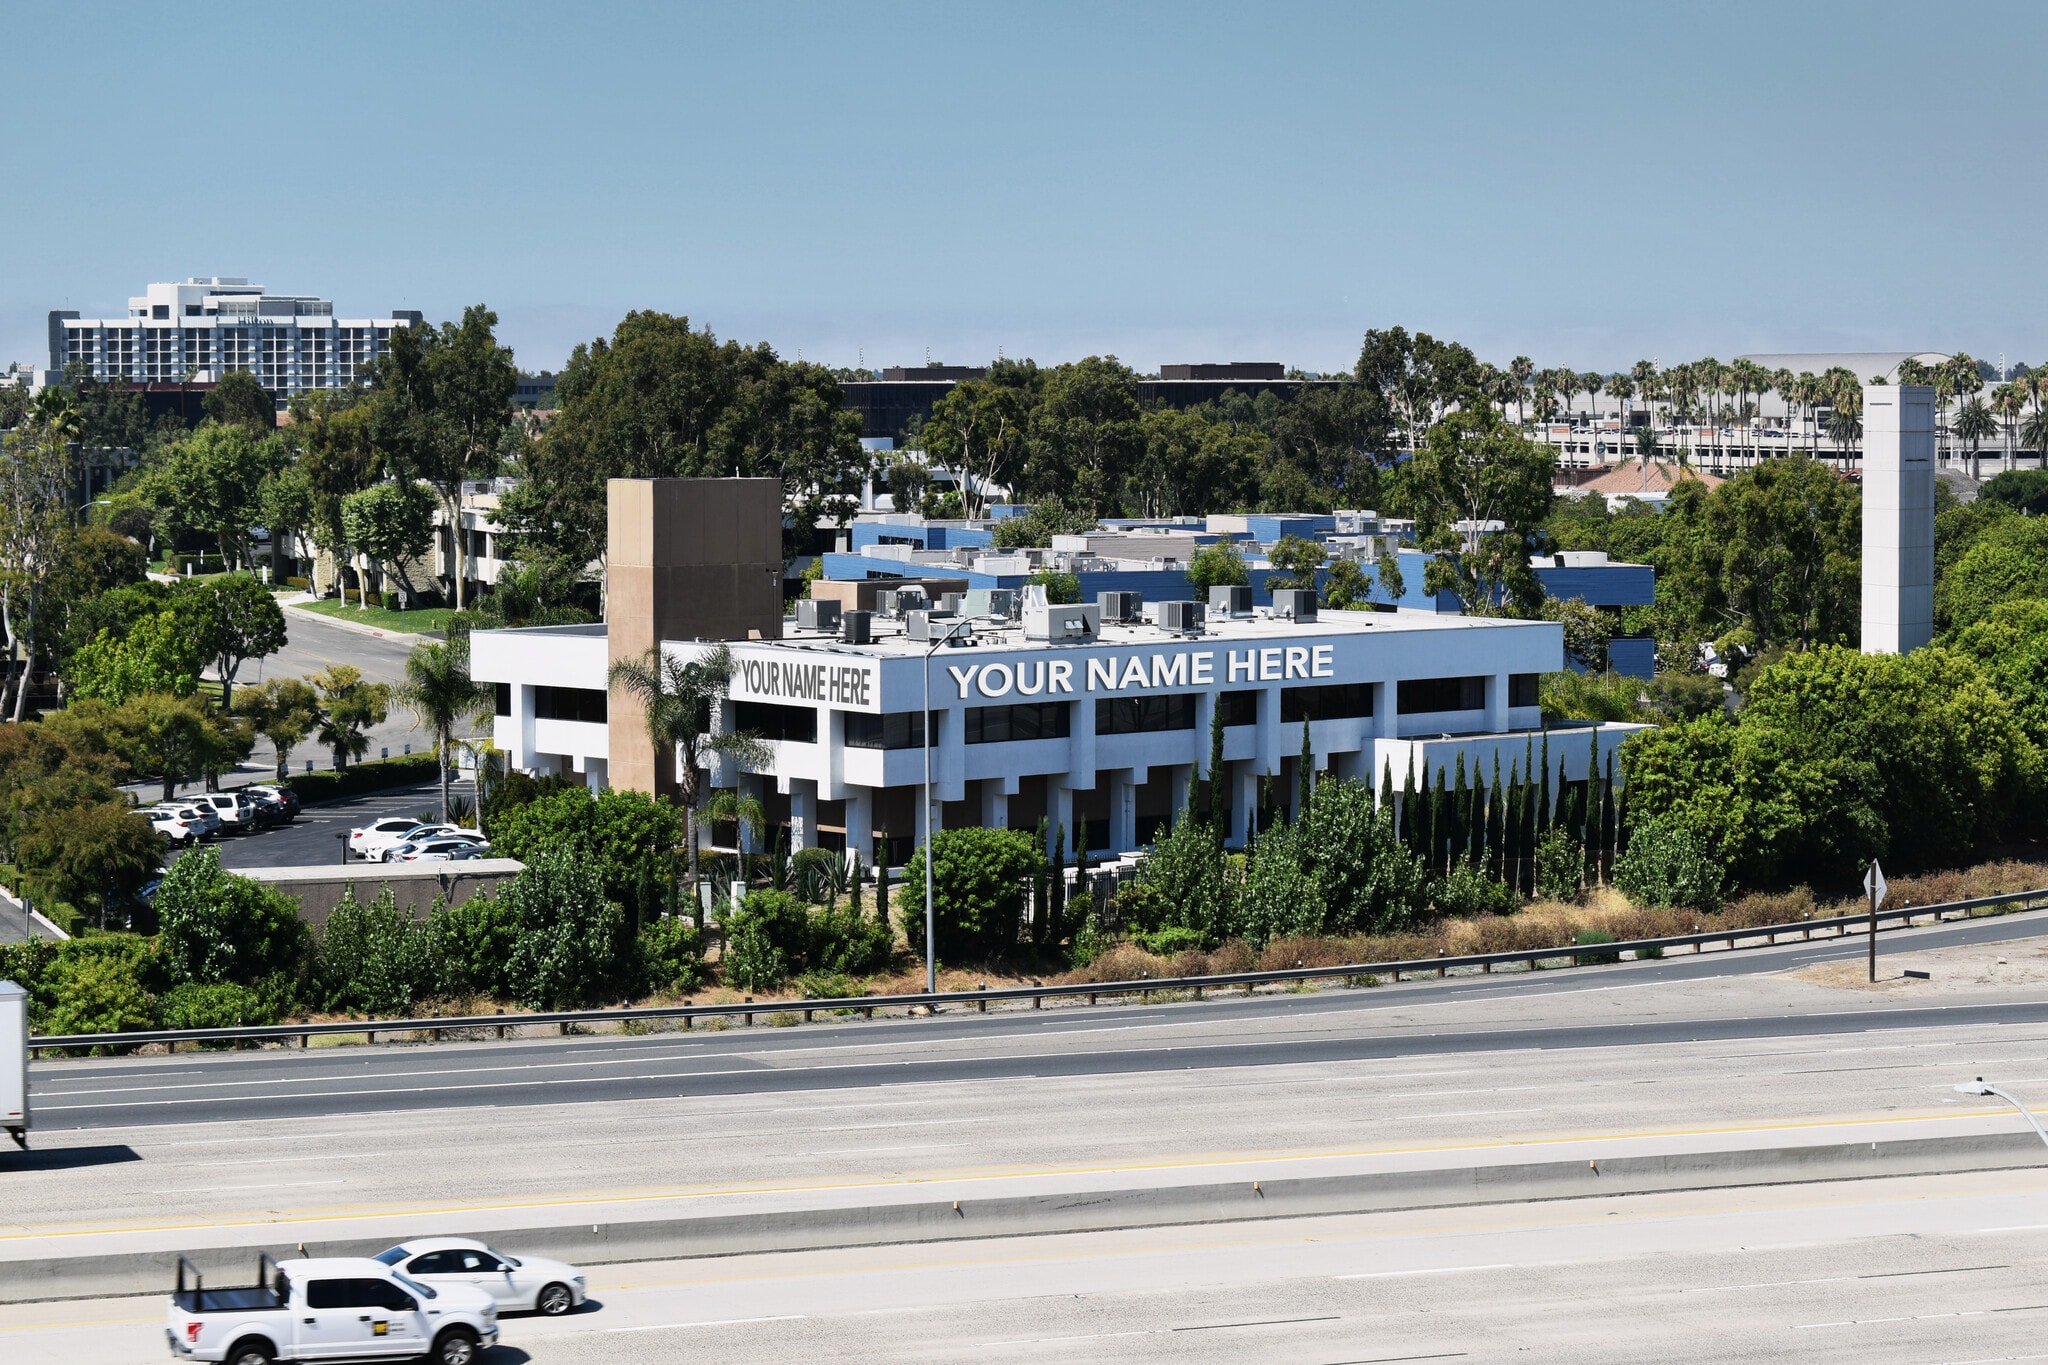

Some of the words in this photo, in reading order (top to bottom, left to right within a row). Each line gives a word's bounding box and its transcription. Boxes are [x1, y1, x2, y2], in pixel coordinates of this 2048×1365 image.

[238, 315, 273, 325] Hilton
[741, 659, 780, 696] YOUR
[782, 662, 826, 701] NAME
[829, 666, 871, 706] HERE
[948, 660, 1074, 699] YOUR
[1086, 651, 1214, 691] NAME
[1227, 644, 1334, 683] HERE
